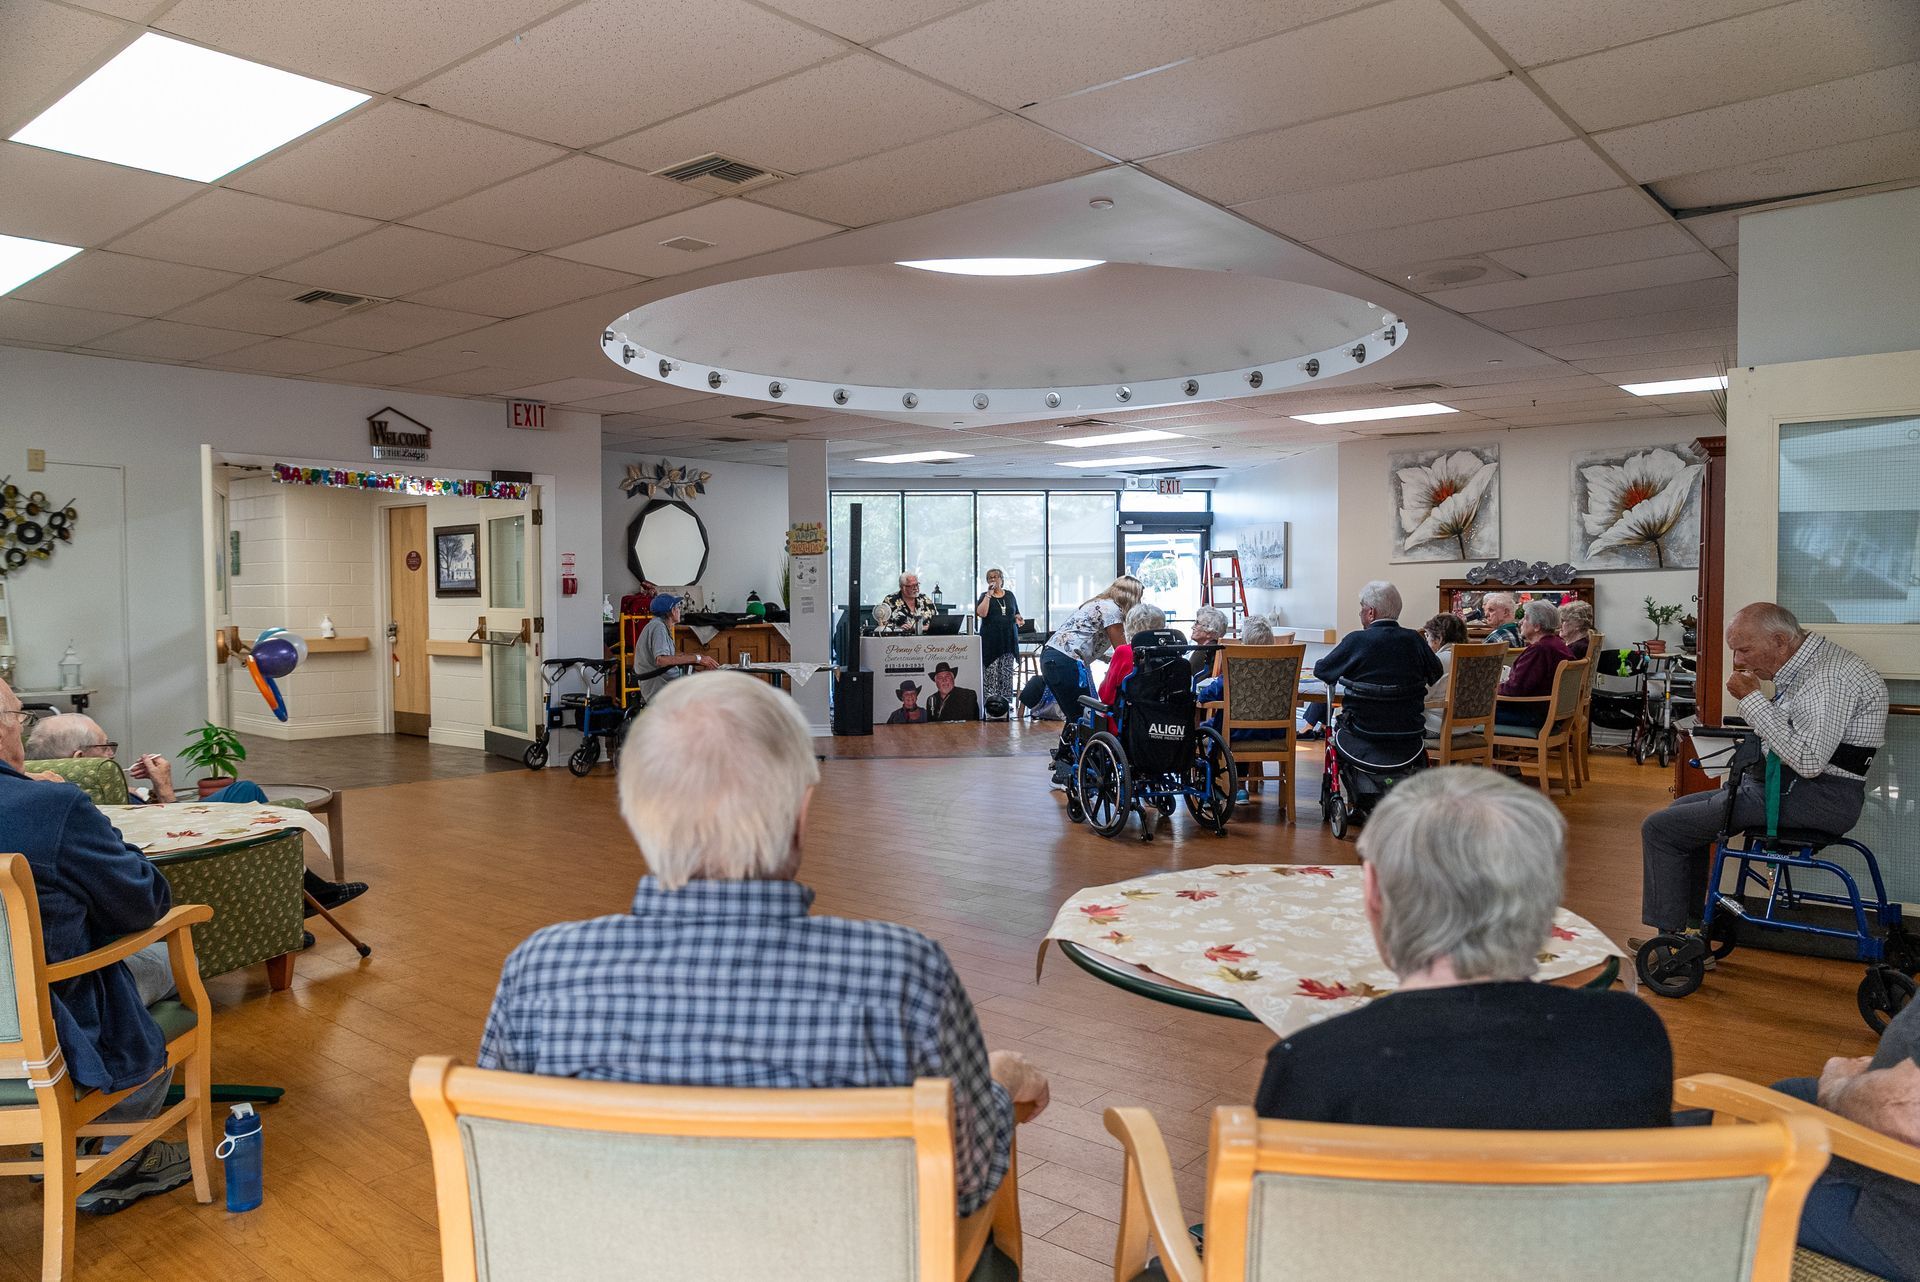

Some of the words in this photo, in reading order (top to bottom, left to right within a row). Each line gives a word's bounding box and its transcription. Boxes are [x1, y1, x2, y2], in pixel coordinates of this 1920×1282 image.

[514, 403, 546, 428] EXIT
[387, 449, 401, 457] THE
[1160, 480, 1180, 494] EXIT
[795, 530, 818, 541] HAPPY
[791, 542, 823, 554] BIRTHDAY
[886, 644, 913, 655] Penny
[913, 644, 922, 653] &
[923, 644, 945, 654] Steve
[945, 643, 968, 655] Lloyd
[884, 654, 924, 663] Entertaining
[924, 653, 947, 662] Music
[1148, 722, 1186, 736] ALIGN
